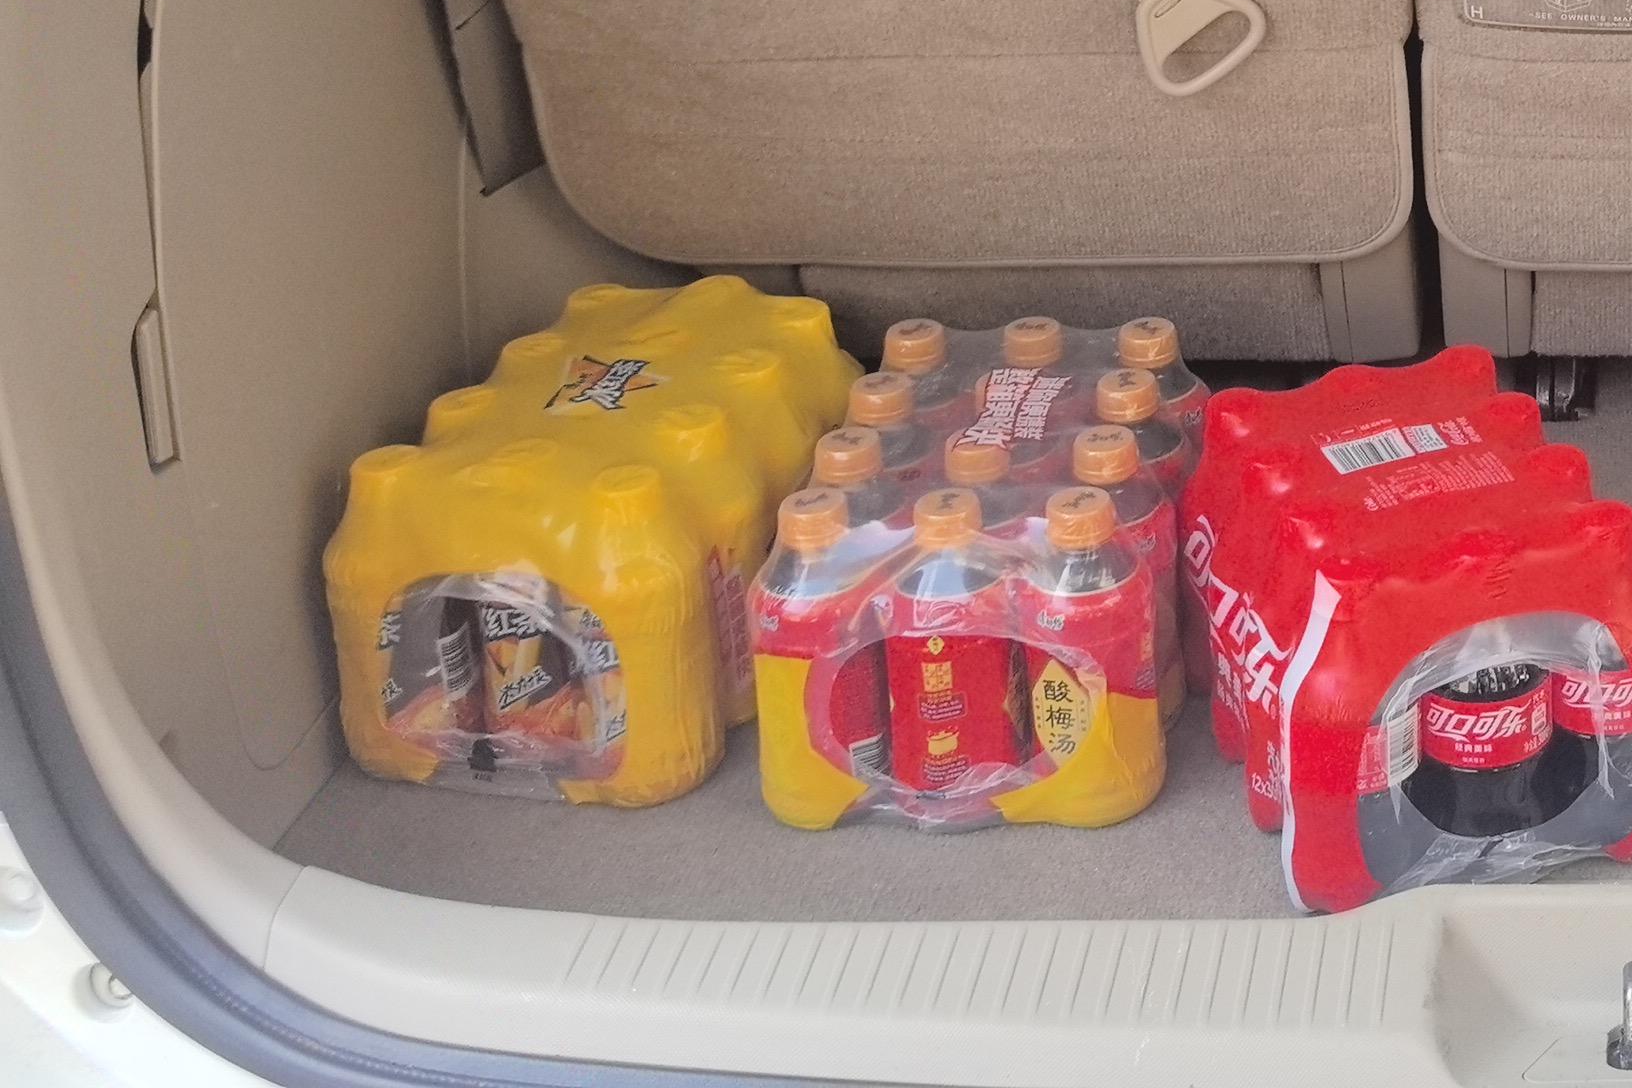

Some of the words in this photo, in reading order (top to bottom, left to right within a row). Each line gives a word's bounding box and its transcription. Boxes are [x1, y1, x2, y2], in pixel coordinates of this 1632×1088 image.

[1471, 5, 1484, 19] H
[1042, 679, 1077, 755] 酸梅汤
[1426, 698, 1533, 744] 可口可乐
